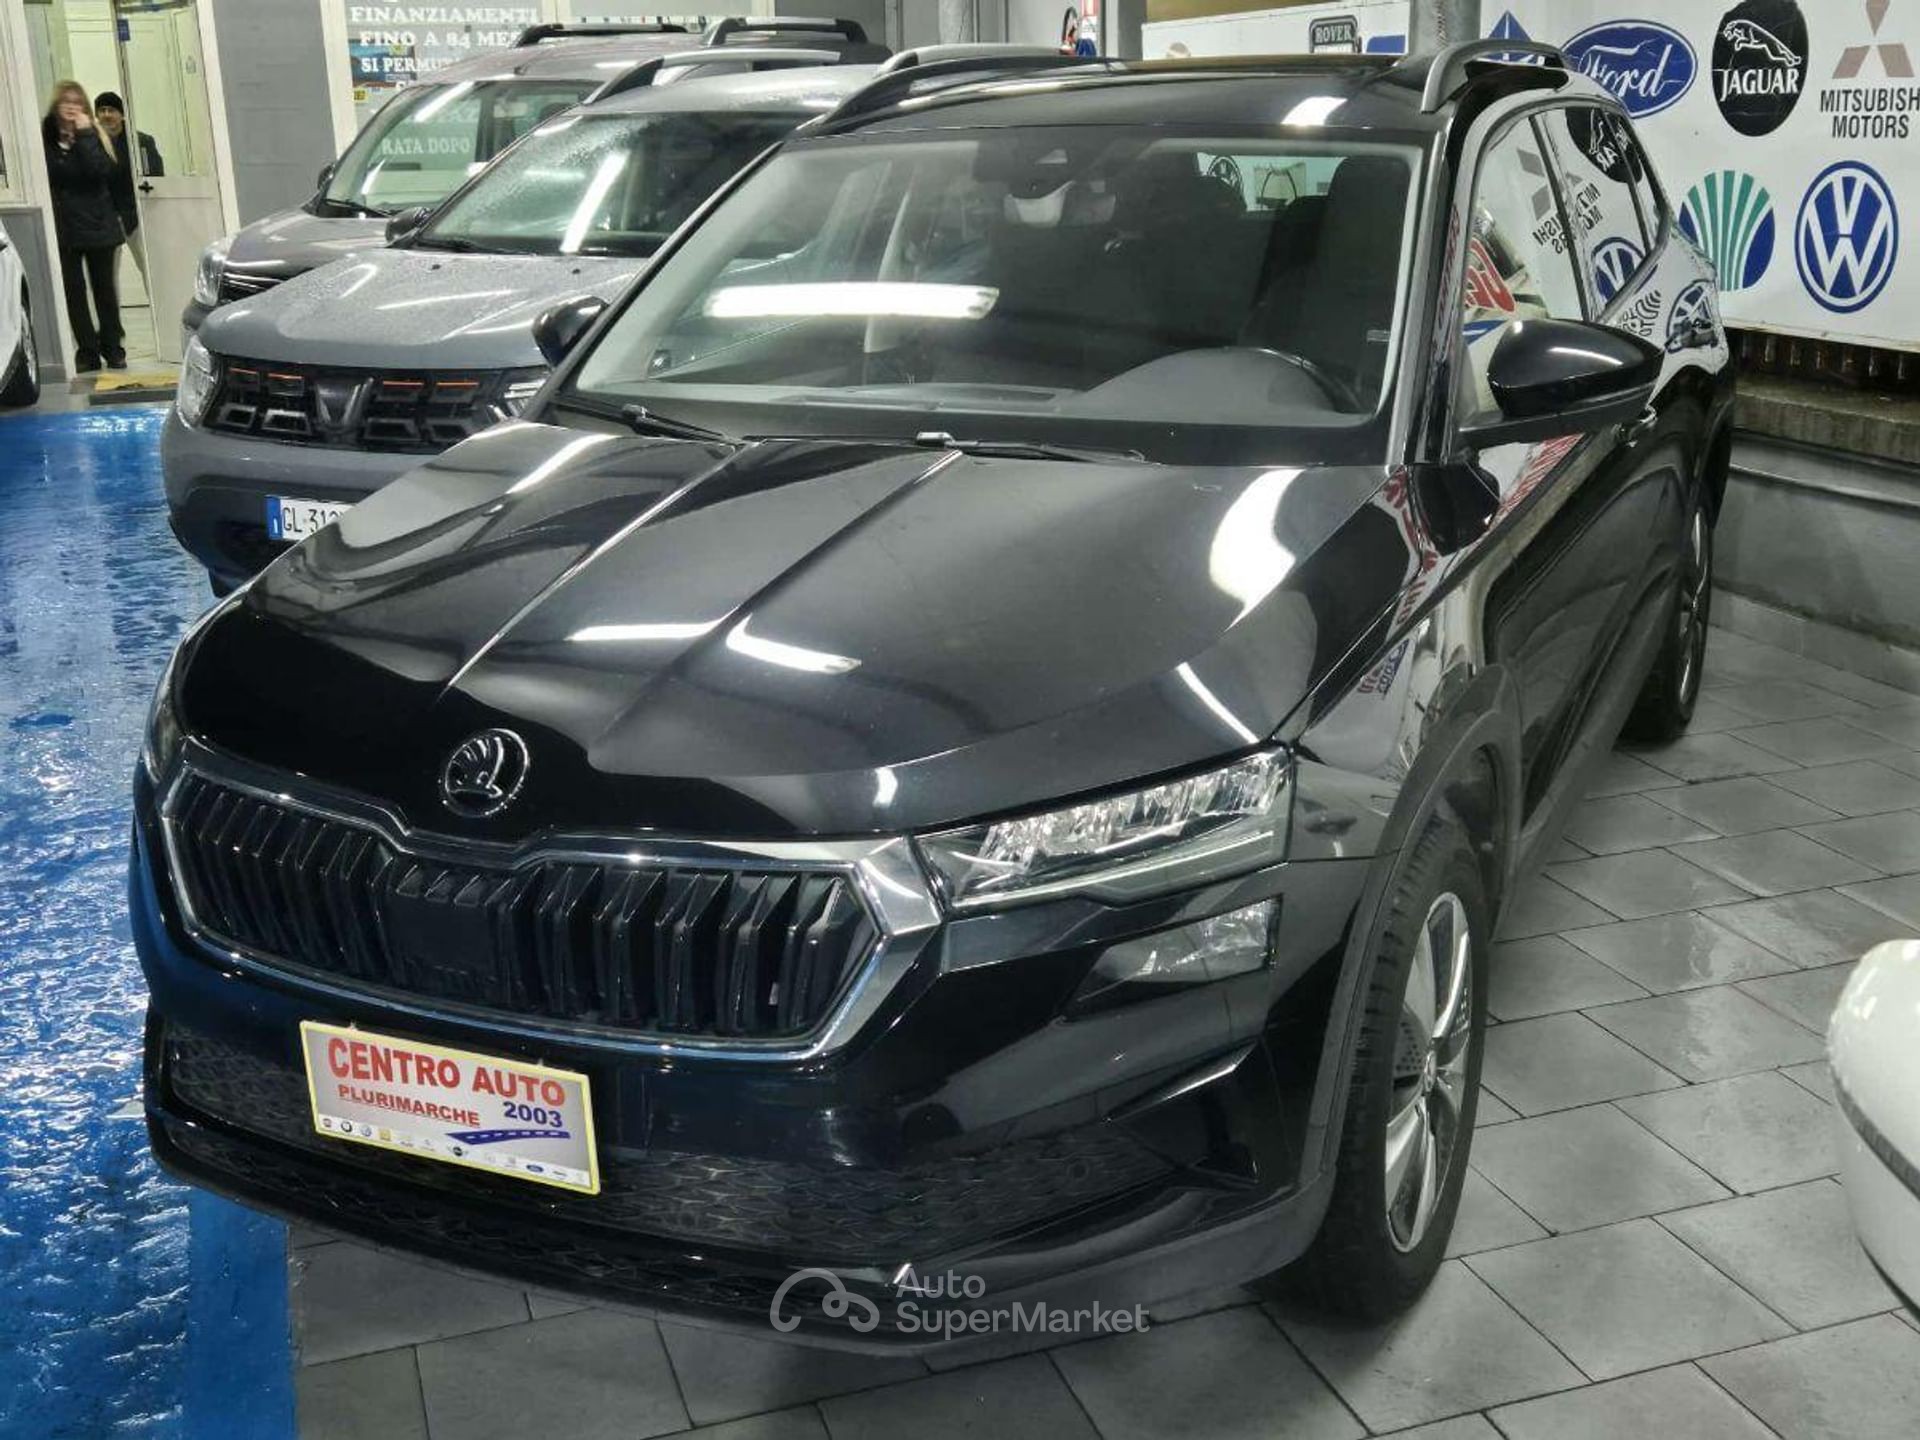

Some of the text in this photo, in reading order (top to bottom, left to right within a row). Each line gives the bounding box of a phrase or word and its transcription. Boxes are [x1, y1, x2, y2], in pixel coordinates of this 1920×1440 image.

[351, 7, 538, 24] FINANZIAMENTI
[360, 31, 416, 47] FINO
[423, 32, 440, 47] A
[361, 57, 379, 72] SI
[1720, 69, 1800, 102] JAGUAR
[1832, 114, 1910, 139] MOTORS
[428, 136, 470, 154] DOPO
[327, 1037, 566, 1107] CENTRO AUTO
[338, 1084, 480, 1126] PLURIMARCHE
[503, 1101, 563, 1128] 2003
